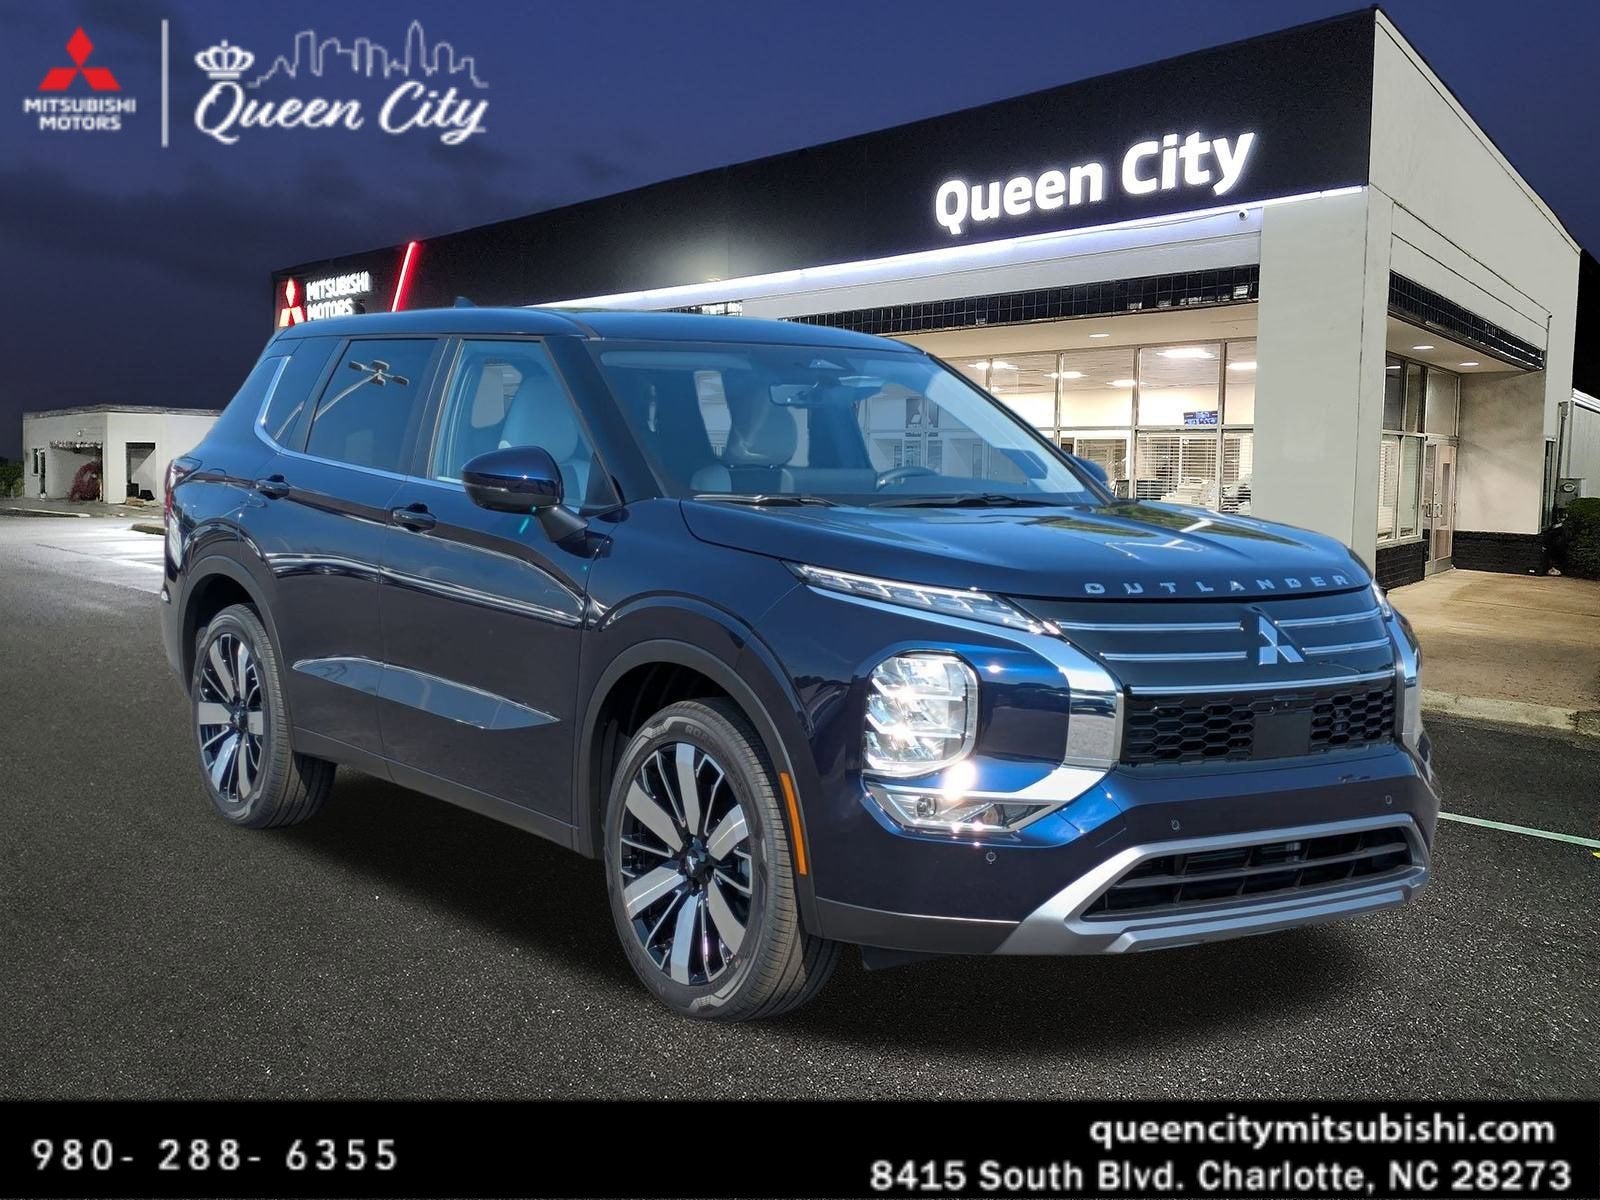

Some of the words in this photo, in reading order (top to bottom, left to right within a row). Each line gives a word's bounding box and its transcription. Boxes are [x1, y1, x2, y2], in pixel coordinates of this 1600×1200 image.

[935, 161, 1104, 235] Queen
[1121, 131, 1255, 196] City
[305, 270, 370, 301] MITSUBISHI
[306, 297, 354, 321] MOTORS
[1084, 574, 1350, 595] OUTLANDER
